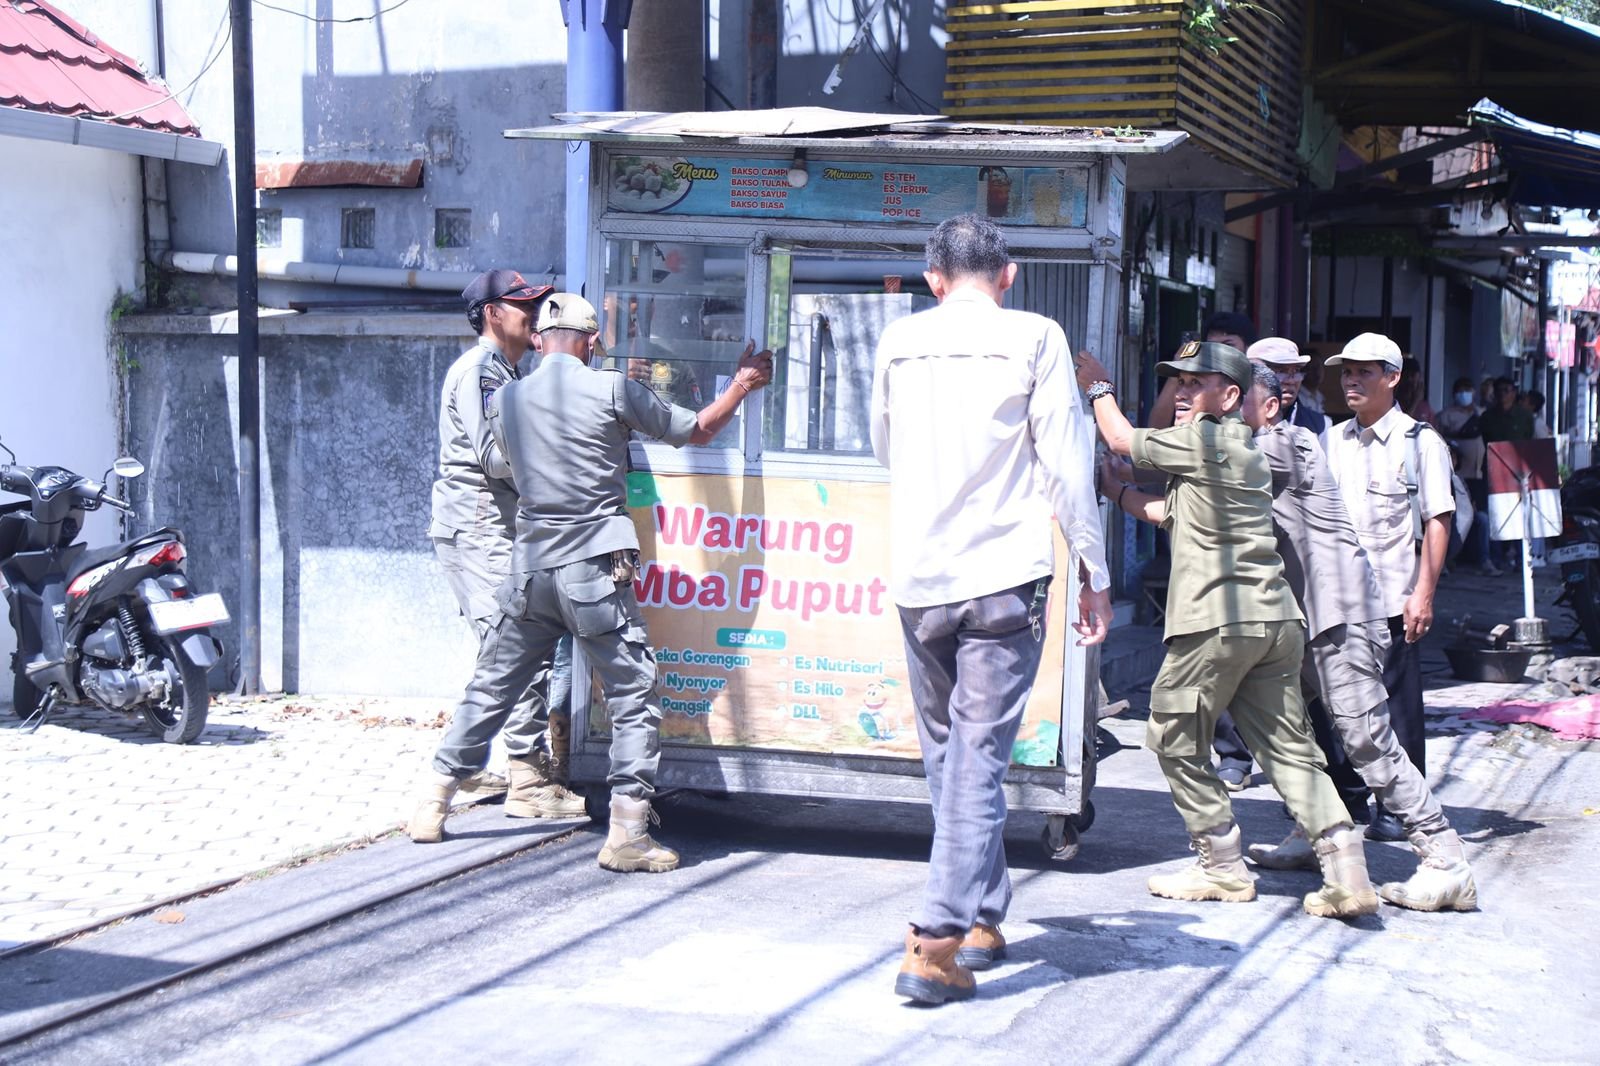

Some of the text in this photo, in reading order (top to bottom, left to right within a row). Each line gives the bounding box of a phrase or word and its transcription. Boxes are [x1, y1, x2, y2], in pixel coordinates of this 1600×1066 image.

[673, 163, 718, 181] Menu
[731, 167, 789, 177] BAKSO CAMP
[823, 168, 873, 181] Minuman
[883, 172, 916, 182] ES TEH
[731, 178, 758, 187] BAKSO
[730, 189, 787, 199] BAKSO SAYUR
[883, 184, 928, 195] ES JERUK
[730, 200, 785, 209] BAKSO BIASA
[883, 196, 902, 206] JUS
[882, 208, 921, 218] POP ICE
[655, 503, 853, 565] Warung
[634, 563, 887, 622] Mba Puput
[728, 632, 768, 645] SEDIA
[655, 648, 751, 669] eka Gorengan
[794, 656, 884, 674] Es Nutrisari
[666, 673, 726, 691] Nyonyor
[793, 680, 845, 696] Es Hilo
[661, 697, 713, 716] Pangsit
[792, 704, 820, 720] DLL
